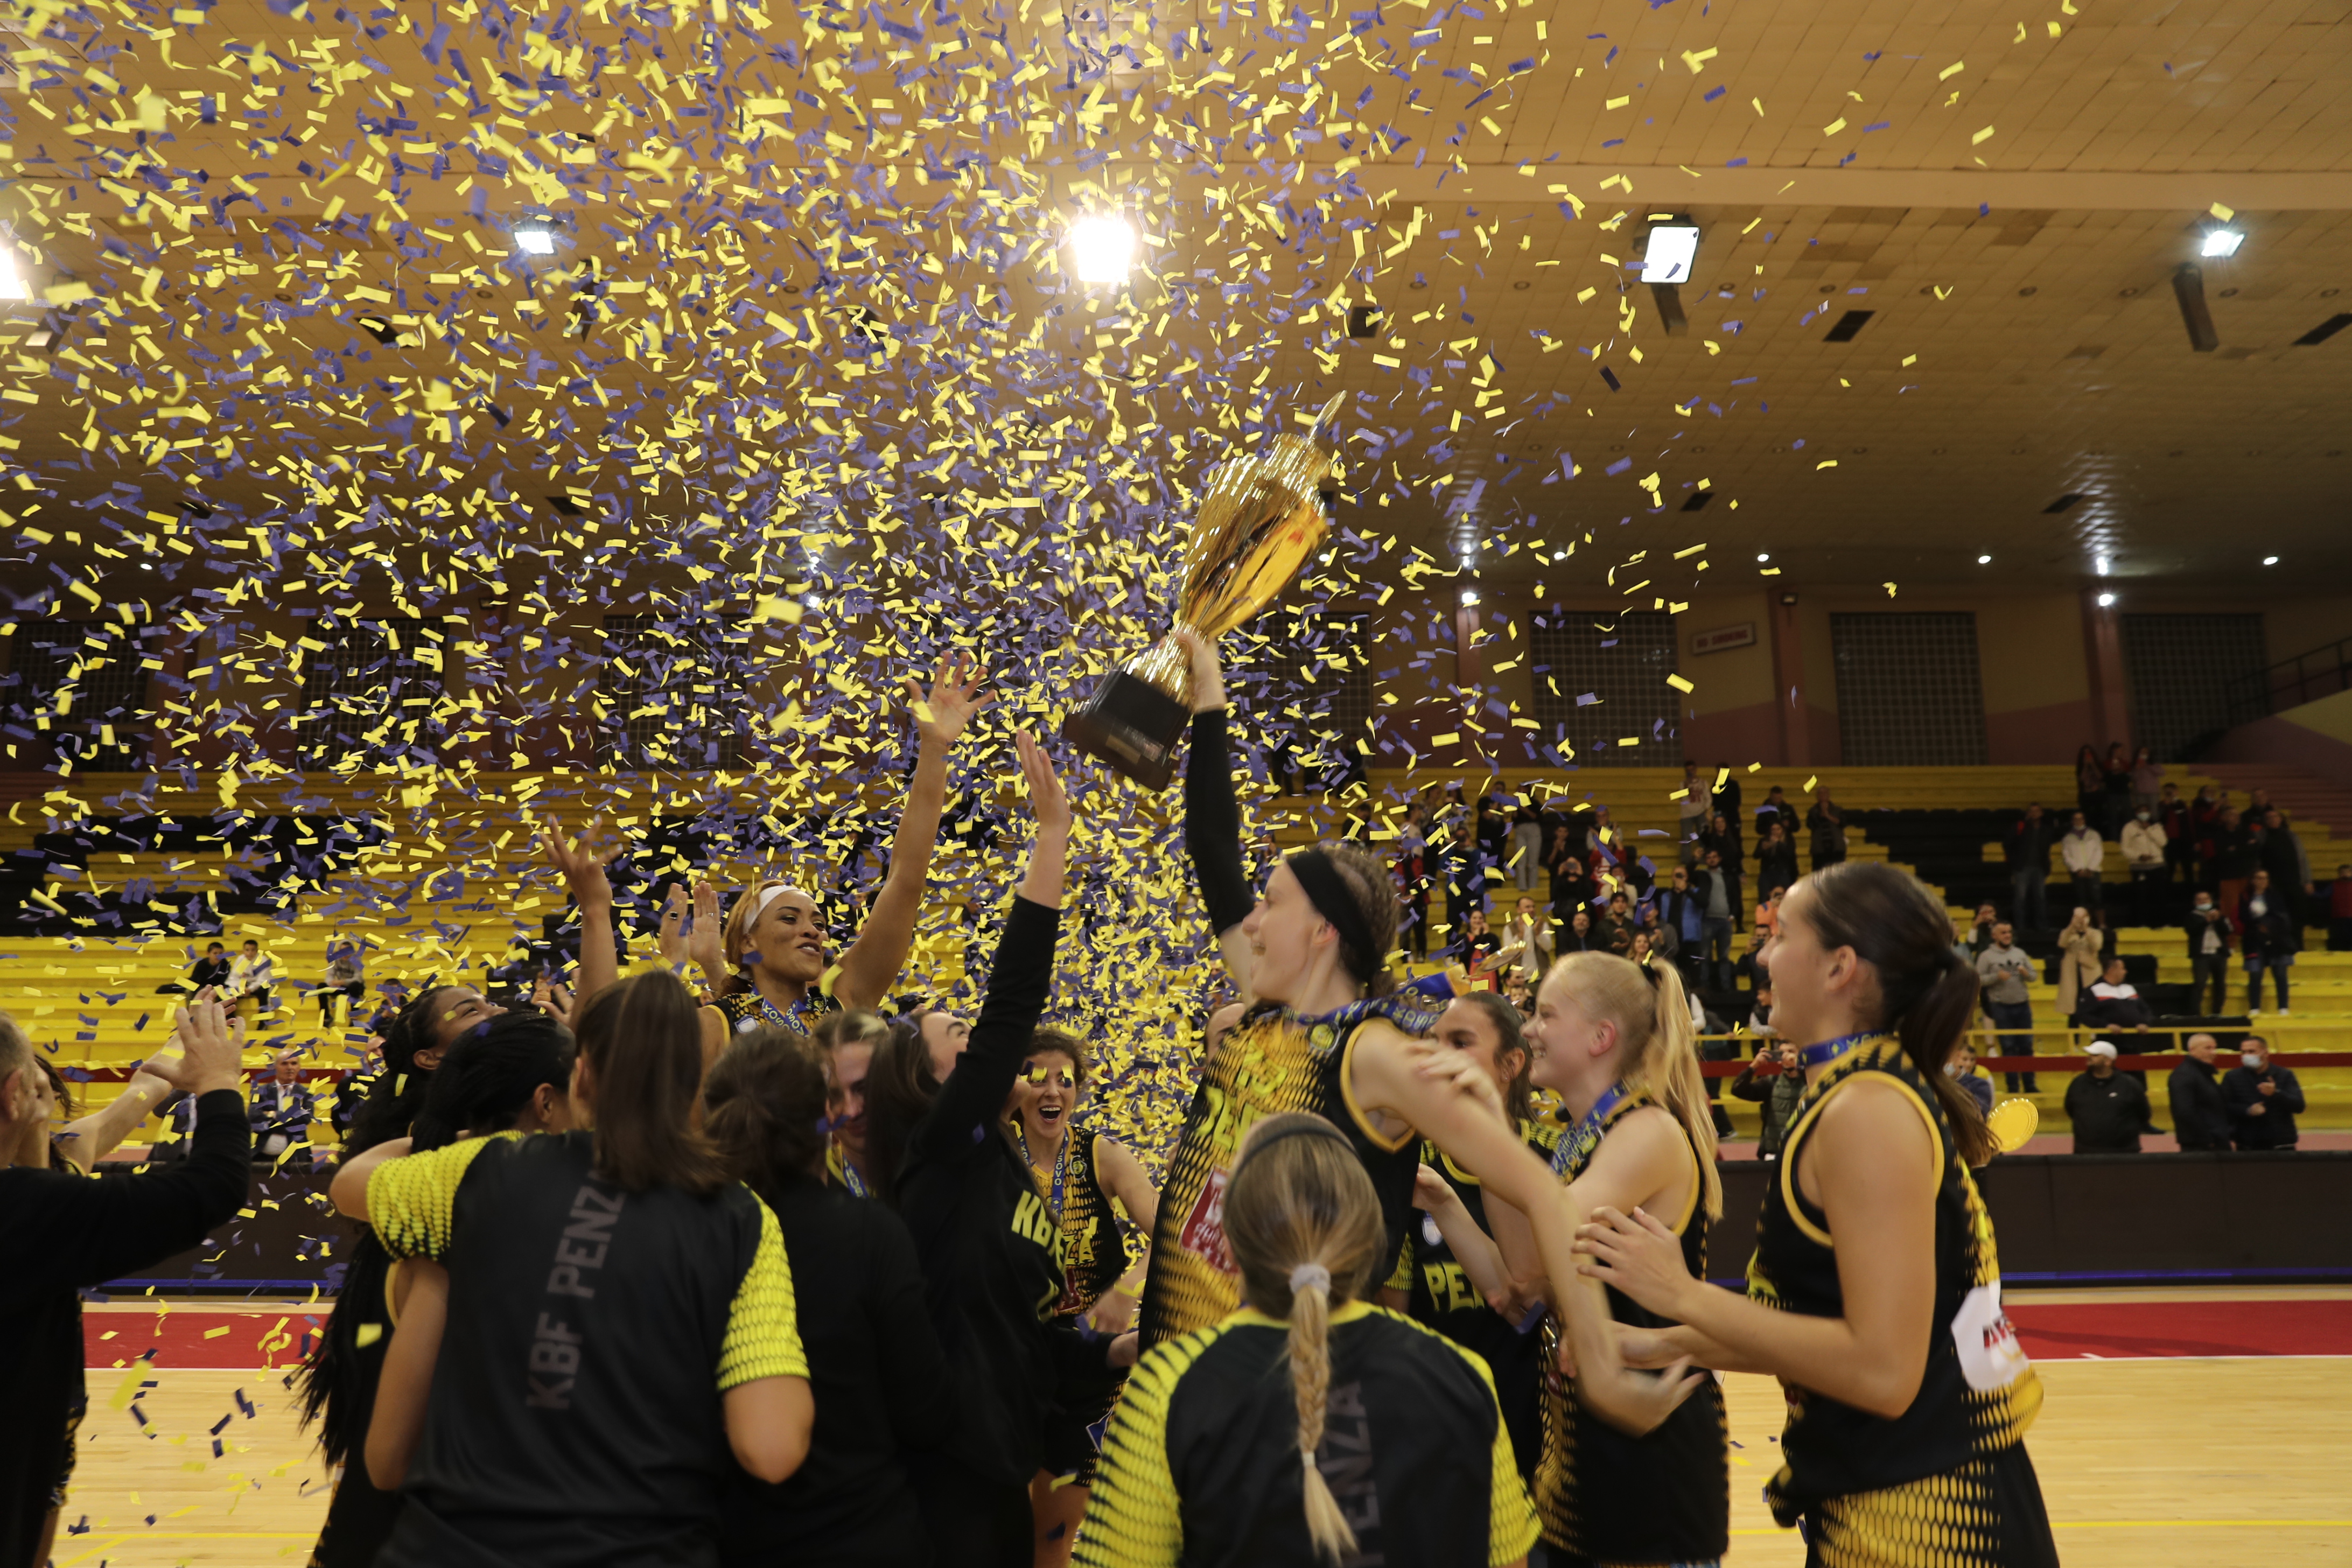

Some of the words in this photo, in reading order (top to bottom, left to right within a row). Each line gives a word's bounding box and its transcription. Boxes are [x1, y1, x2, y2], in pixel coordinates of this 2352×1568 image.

[1054, 1148, 1063, 1186] SOVO
[547, 1171, 626, 1299] PENZ
[526, 1312, 582, 1410] KBF
[1318, 1380, 1386, 1567] ENZA
